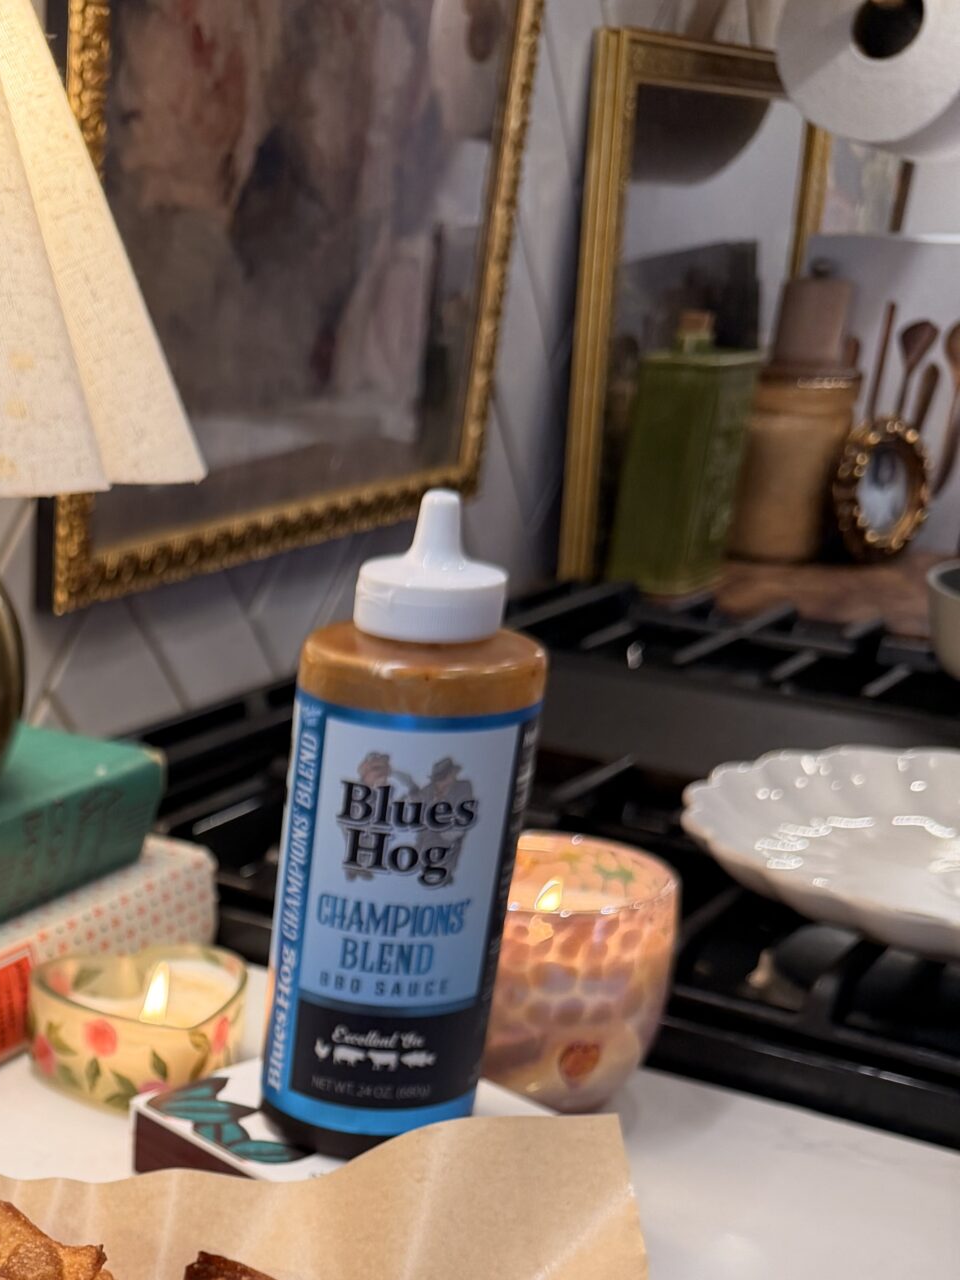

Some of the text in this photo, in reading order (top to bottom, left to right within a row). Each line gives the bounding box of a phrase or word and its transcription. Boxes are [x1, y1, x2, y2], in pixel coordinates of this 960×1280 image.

[294, 732, 321, 810] BLEND
[336, 779, 478, 830] Blues
[342, 827, 452, 888] Hog
[276, 947, 297, 1008] Hog
[319, 970, 450, 998] BBQ SAUCE
[338, 937, 435, 976] BLEND
[267, 1008, 288, 1094] Blues
[311, 1075, 335, 1092] NET
